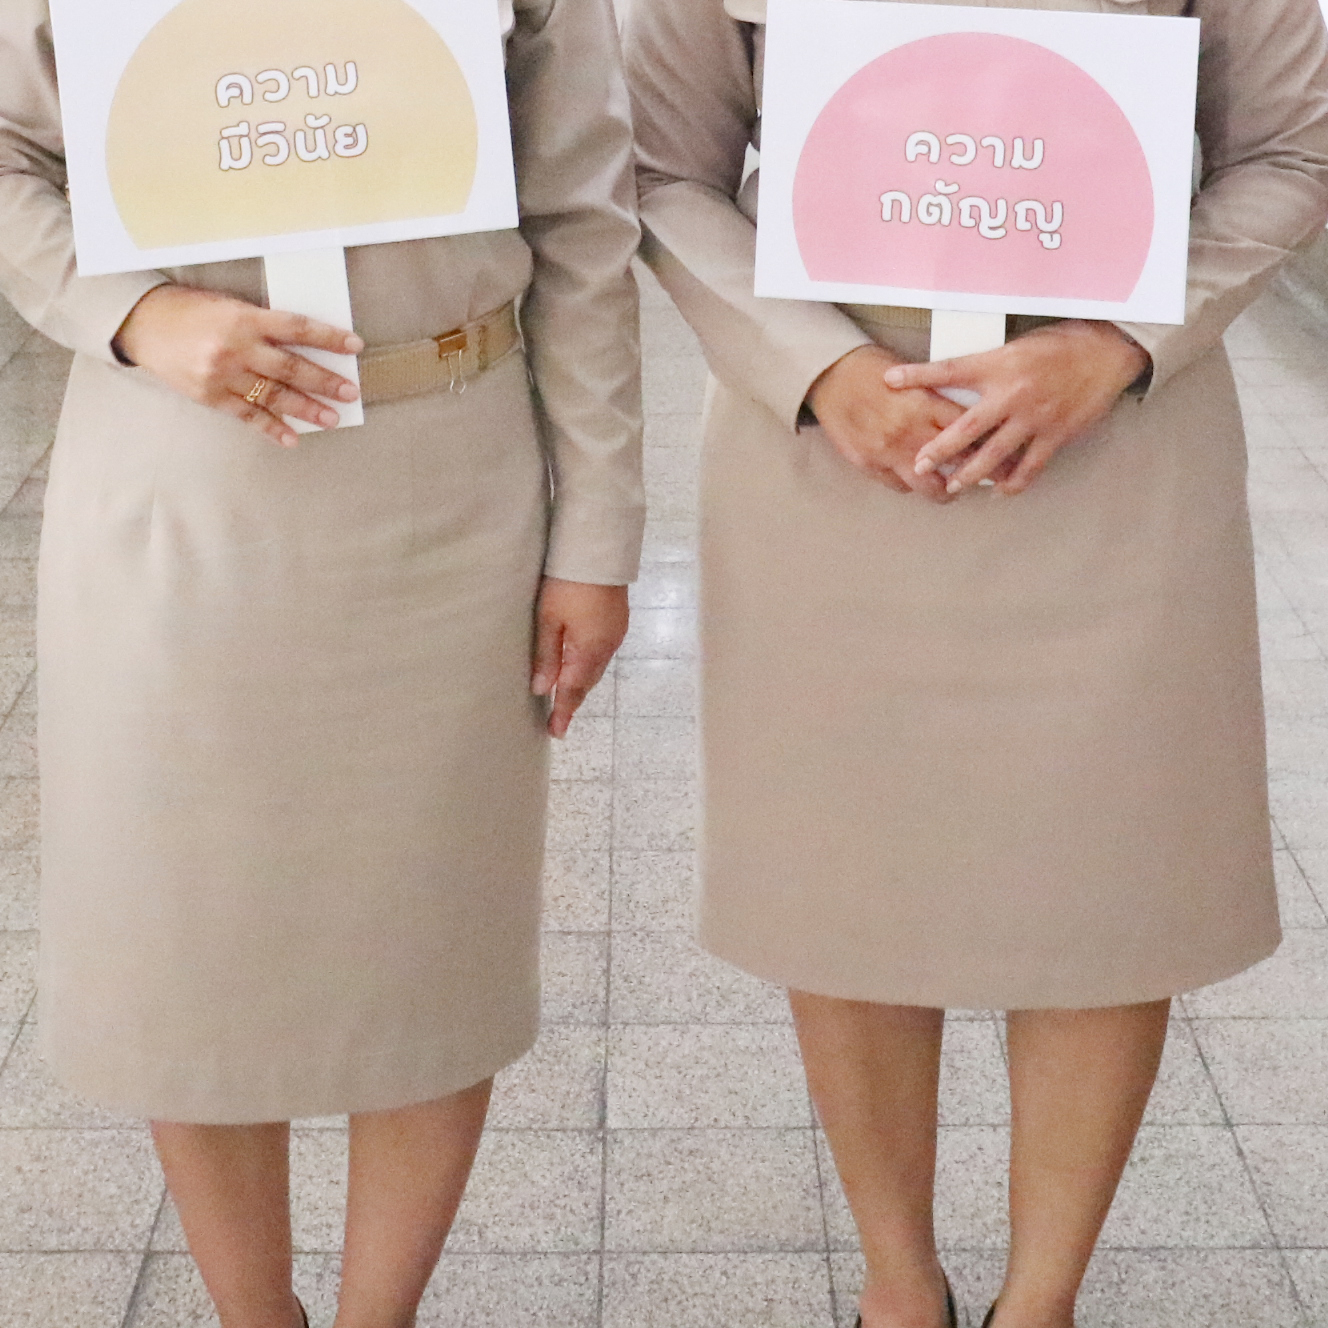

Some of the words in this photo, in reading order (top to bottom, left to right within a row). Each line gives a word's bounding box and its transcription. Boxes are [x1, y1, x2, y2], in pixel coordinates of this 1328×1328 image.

[215, 60, 359, 108] ความ
[218, 113, 369, 172] มีวินัย
[905, 130, 1045, 170] ความ
[879, 179, 1064, 251] กตัญญู
